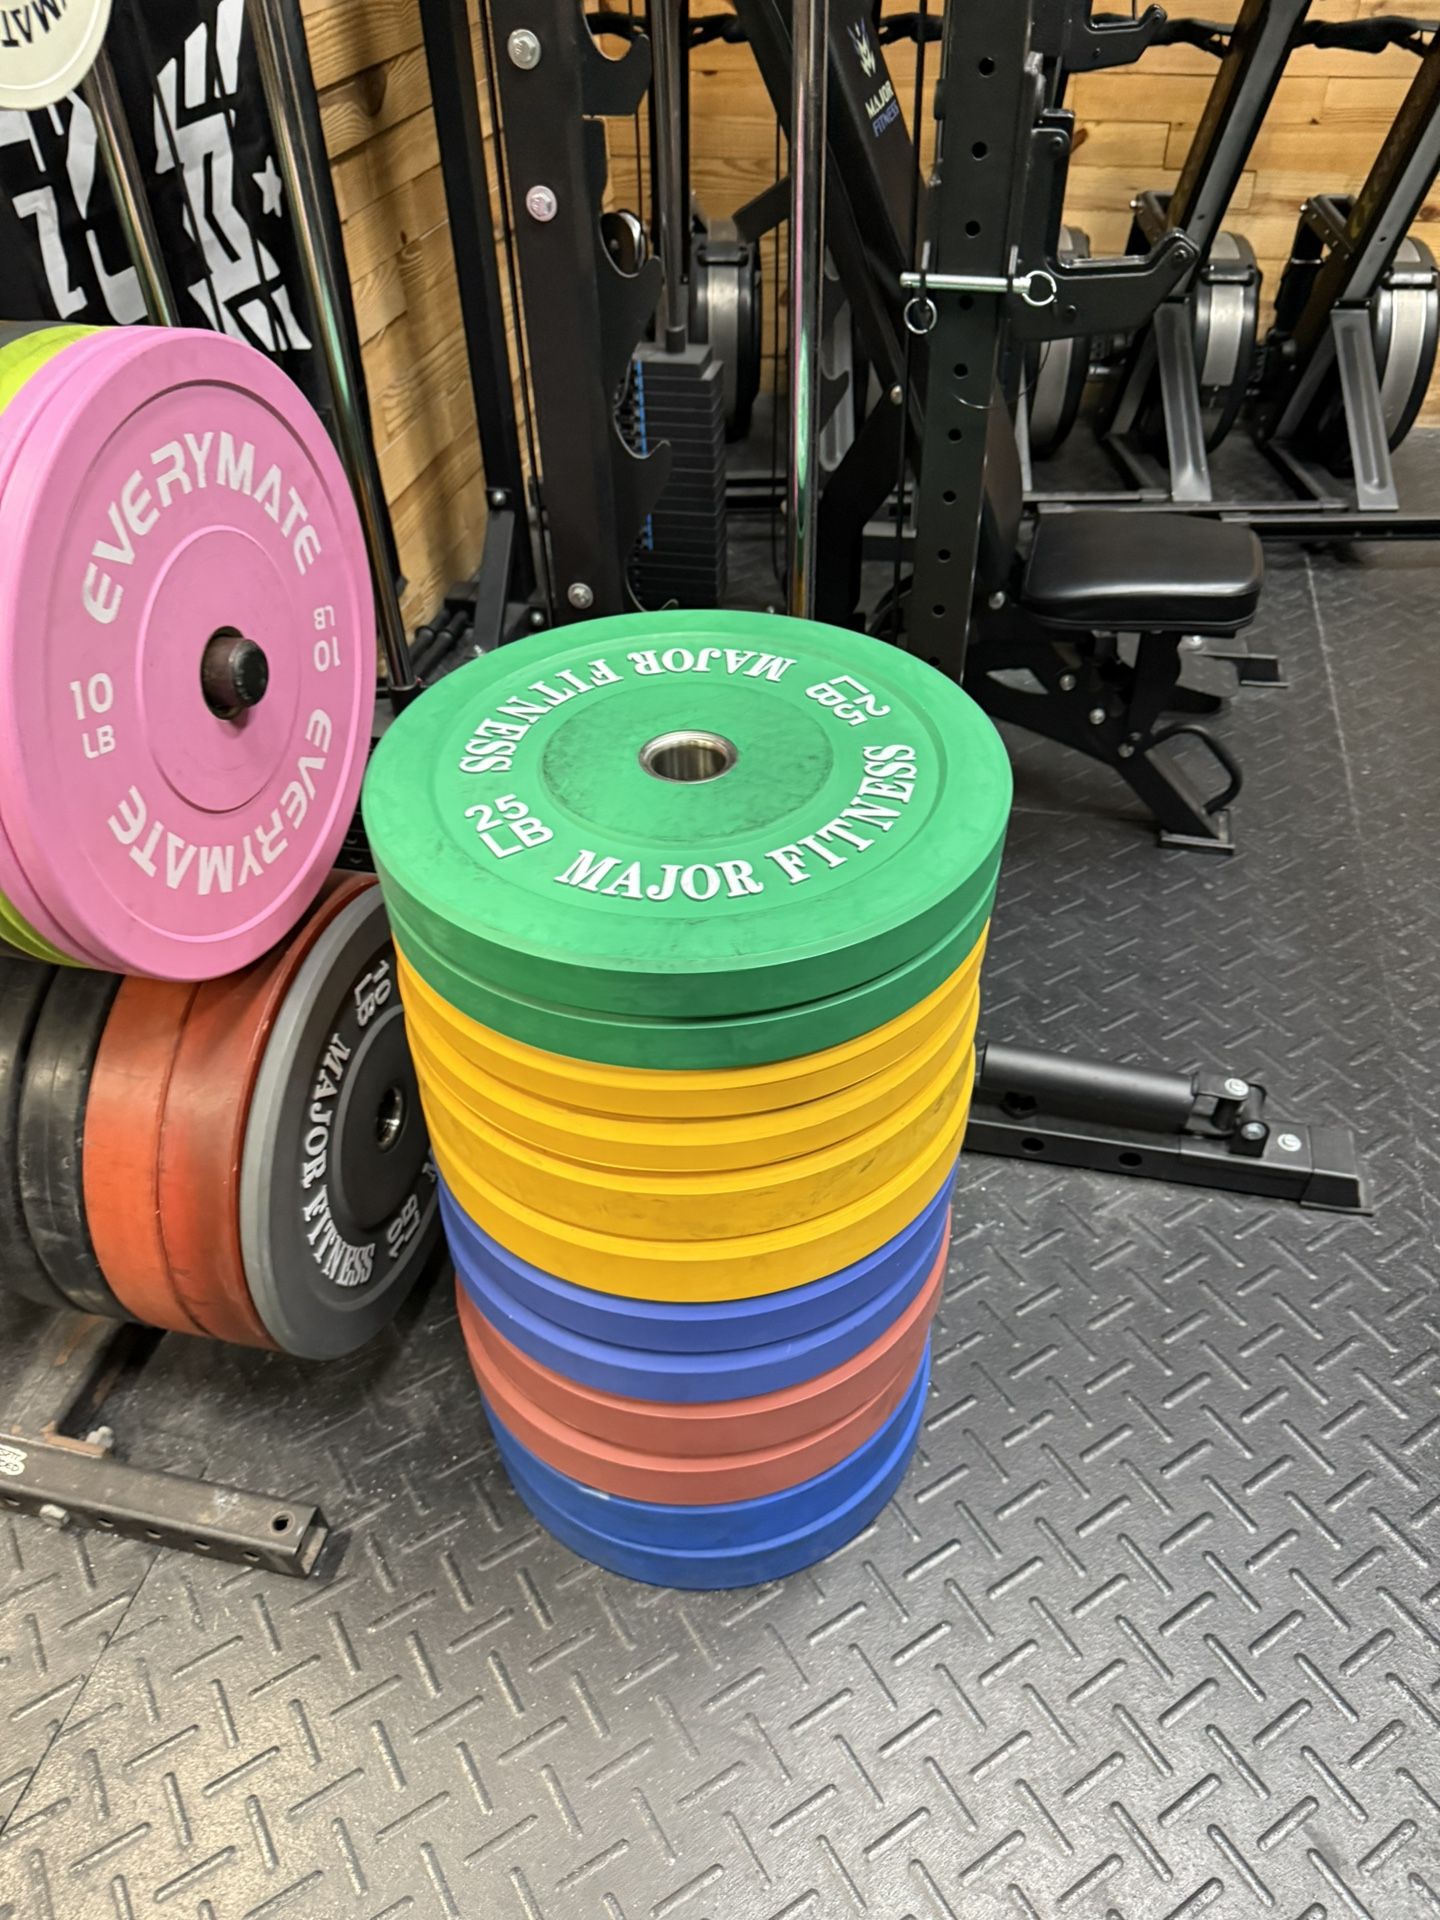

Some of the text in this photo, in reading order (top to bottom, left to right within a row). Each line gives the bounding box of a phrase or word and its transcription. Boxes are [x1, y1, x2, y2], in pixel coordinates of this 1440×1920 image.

[865, 80, 894, 119] MAJOR
[872, 99, 900, 137] FITNESS
[83, 431, 321, 624] EVERYMATE
[313, 605, 335, 630] LB
[313, 636, 341, 672] 10
[70, 673, 114, 720] 10
[459, 648, 797, 774] MAJOR FITNESS
[805, 675, 871, 708] LB
[833, 694, 891, 726] 25
[82, 725, 116, 759] LB
[107, 709, 332, 895] EVERYMATE
[464, 793, 530, 833] 25
[555, 744, 918, 900] MAJOR FITNESS
[479, 817, 554, 859] LB
[354, 972, 375, 1026] LB
[372, 960, 391, 1005] 10
[301, 1033, 376, 1286] MAJOR FITNESS
